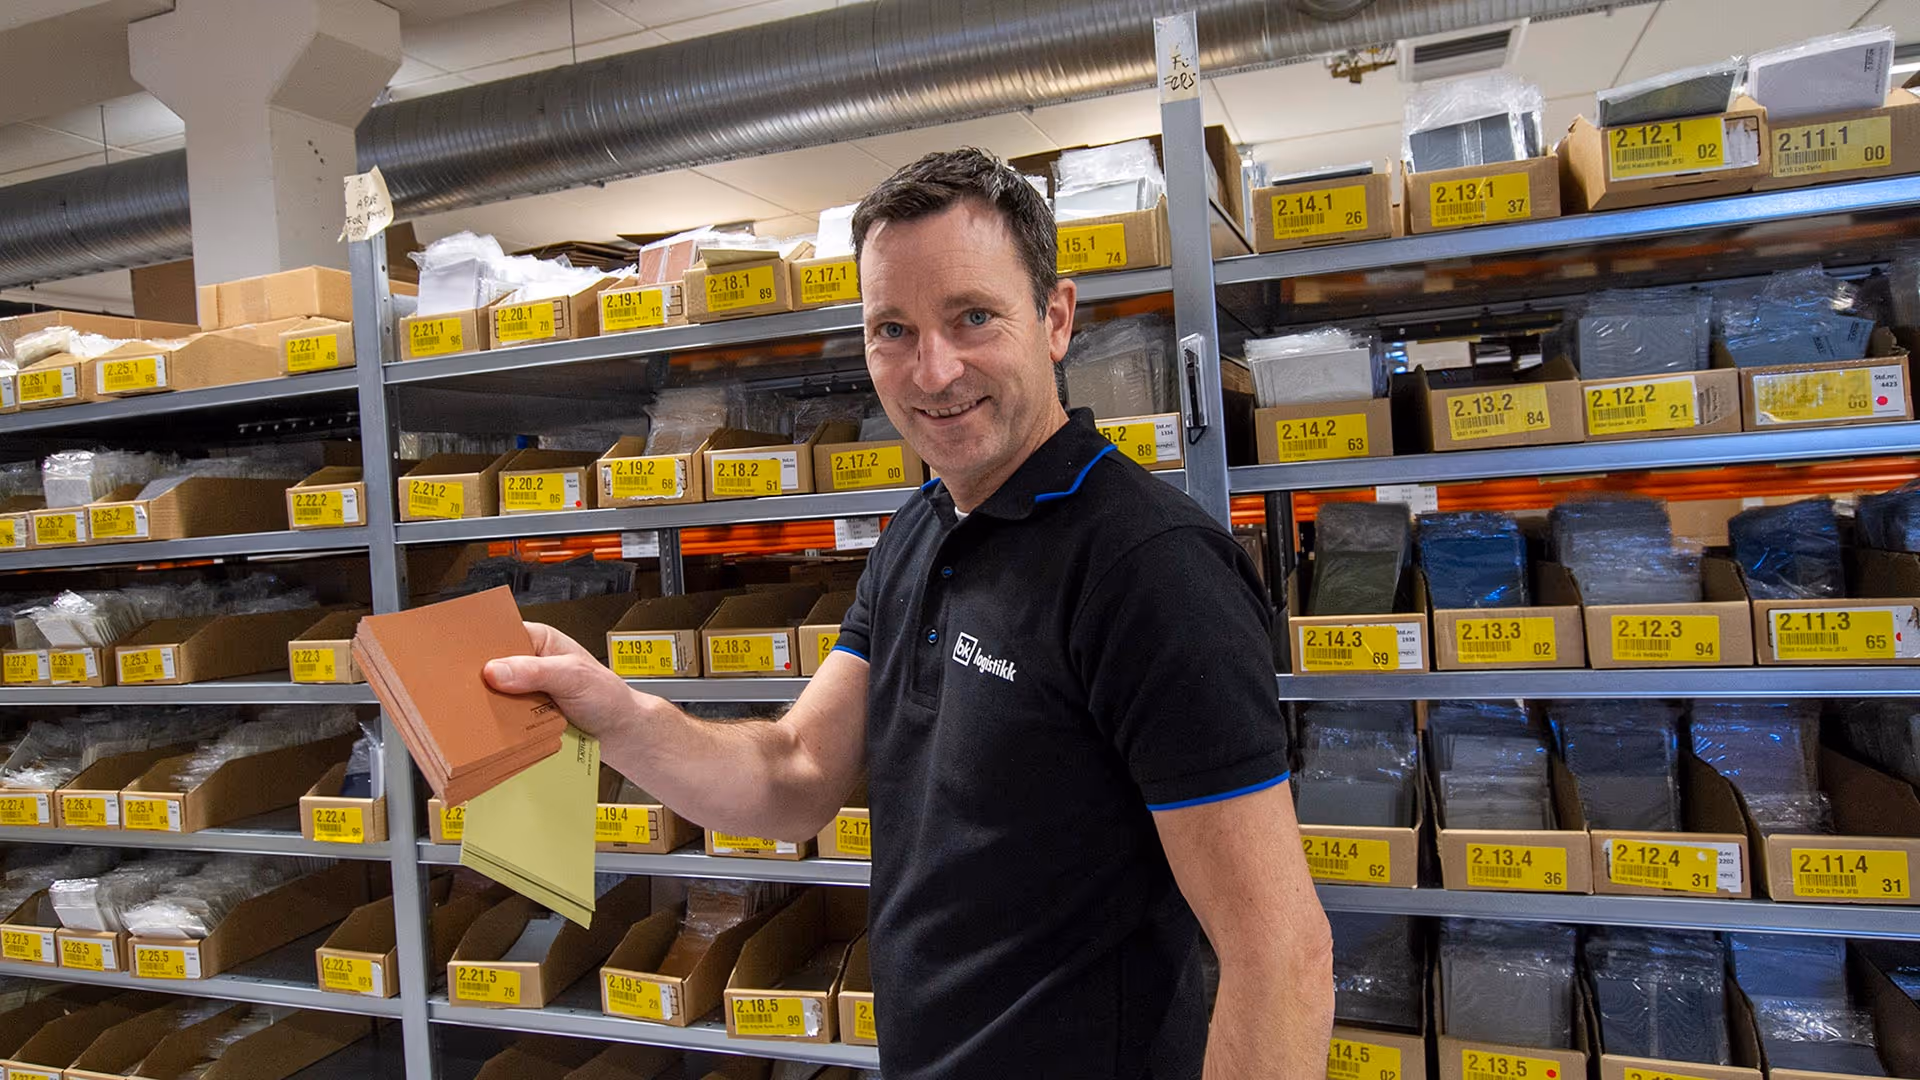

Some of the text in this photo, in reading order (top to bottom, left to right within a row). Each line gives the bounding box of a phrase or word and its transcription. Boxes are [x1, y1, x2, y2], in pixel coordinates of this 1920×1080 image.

[1615, 122, 1682, 148] 2.12.1
[1778, 126, 1848, 153] 2.11.1
[1697, 143, 1717, 160] 02
[1864, 145, 1885, 161] 00
[1436, 181, 1494, 203] 2.13.1
[1277, 193, 1333, 217] 2.14.1
[1507, 199, 1525, 213] 37
[1345, 211, 1363, 225] 26
[1106, 252, 1121, 264] 74
[804, 266, 847, 284] 2.17.1
[709, 273, 751, 293] 2.18.1
[606, 291, 643, 309] 2.19.1
[759, 287, 772, 300] 89
[500, 306, 533, 322] 2.20.1
[651, 306, 661, 317] 12
[413, 322, 444, 338] 2.21.1
[539, 320, 550, 331] 70
[290, 338, 321, 353] 2.22.1
[450, 336, 461, 345] 96
[107, 363, 139, 376] 2.25.1
[21, 374, 48, 387] 2.26.1
[1874, 373, 1897, 381] Std.nr:
[1592, 384, 1657, 408] 2.12.2
[1453, 394, 1514, 417] 2.13.2
[1669, 403, 1688, 419] 21
[1527, 411, 1545, 425] 84
[1282, 420, 1337, 440] 2.14.2
[1137, 444, 1152, 457] 88
[1348, 437, 1364, 452] 63
[616, 461, 655, 475] 2.19.2
[835, 452, 879, 471] 2.17.2
[717, 462, 759, 478] 2.18.2
[887, 466, 901, 479] 00
[413, 481, 446, 498] 2.21.2
[507, 477, 544, 491] 2.20.2
[662, 478, 674, 490] 68
[766, 480, 778, 491] 51
[295, 494, 328, 507] 2.22.2
[549, 493, 561, 504] 06
[93, 506, 121, 523] 2.25.2
[37, 517, 64, 529] 2.26.2
[1779, 612, 1851, 631] 2.11.3
[1462, 622, 1522, 641] 2.13.3
[1617, 620, 1683, 638] 2.12.3
[822, 637, 830, 652] 2
[1306, 630, 1363, 647] 2.14.3
[1865, 634, 1887, 650] 65
[617, 640, 653, 654] 2.19.3
[713, 639, 751, 654] 2.18.3
[1534, 642, 1551, 656] 02
[1695, 642, 1714, 656] 94
[51, 655, 74, 666] 2.26.3
[123, 653, 149, 667] 2.25.3
[294, 650, 320, 663] 2.22.3
[660, 657, 671, 668] 05
[758, 655, 770, 667] 14
[1373, 652, 1389, 665] 69
[972, 647, 1017, 682] logistikk
[0, 799, 25, 811] 2.27.4
[66, 799, 93, 811] 2.26.4
[128, 802, 154, 813] 2.25.4
[316, 810, 346, 824] 2.22.4
[596, 807, 628, 821] .19.4
[635, 825, 645, 836] 77
[840, 820, 869, 836] 2.17
[1303, 839, 1359, 859] 2.14.4
[1616, 844, 1681, 867] 2.12.4
[1472, 847, 1533, 867] 2.13.4
[1799, 854, 1868, 874] 2.11.4
[1369, 864, 1385, 878] 62
[1544, 872, 1562, 886] 36
[1691, 873, 1710, 888] 31
[1882, 878, 1901, 893] 31
[4, 933, 29, 946] 2.27.5
[63, 941, 90, 955] 2.26.5
[139, 950, 169, 963] 2.25.5
[176, 965, 184, 975] 15
[324, 957, 353, 973] 2.22.5
[459, 967, 497, 984] 2.21.5
[609, 975, 642, 994] 2.19.5
[504, 987, 515, 998] 76
[736, 999, 779, 1014] 2.18.5
[859, 1006, 872, 1020] 2.
[787, 1015, 801, 1027] 99
[1328, 1043, 1370, 1063] .14.5
[1468, 1054, 1527, 1077] 2.13.5
